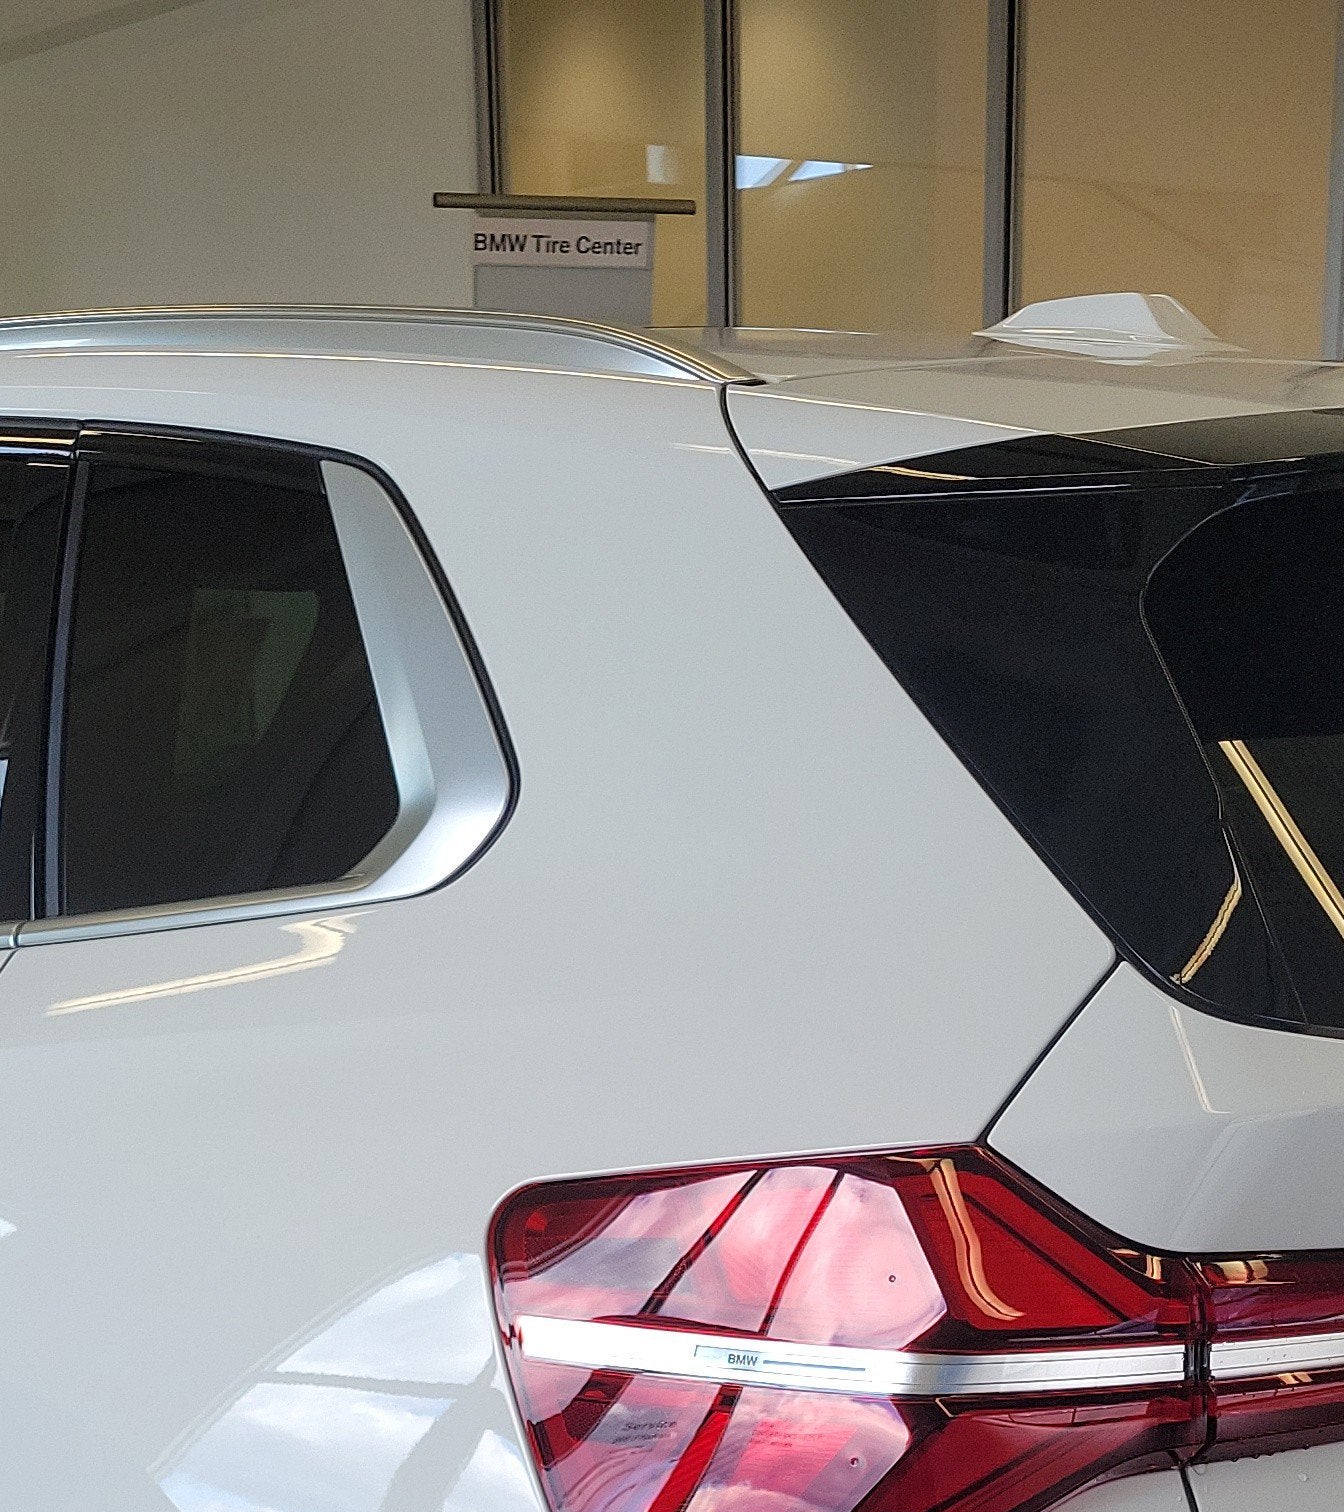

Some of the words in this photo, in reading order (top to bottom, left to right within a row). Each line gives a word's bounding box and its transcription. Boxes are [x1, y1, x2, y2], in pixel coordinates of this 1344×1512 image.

[473, 233, 527, 252] BMW
[532, 235, 571, 254] Tire
[576, 236, 642, 255] Center
[727, 1353, 759, 1367] BMW
